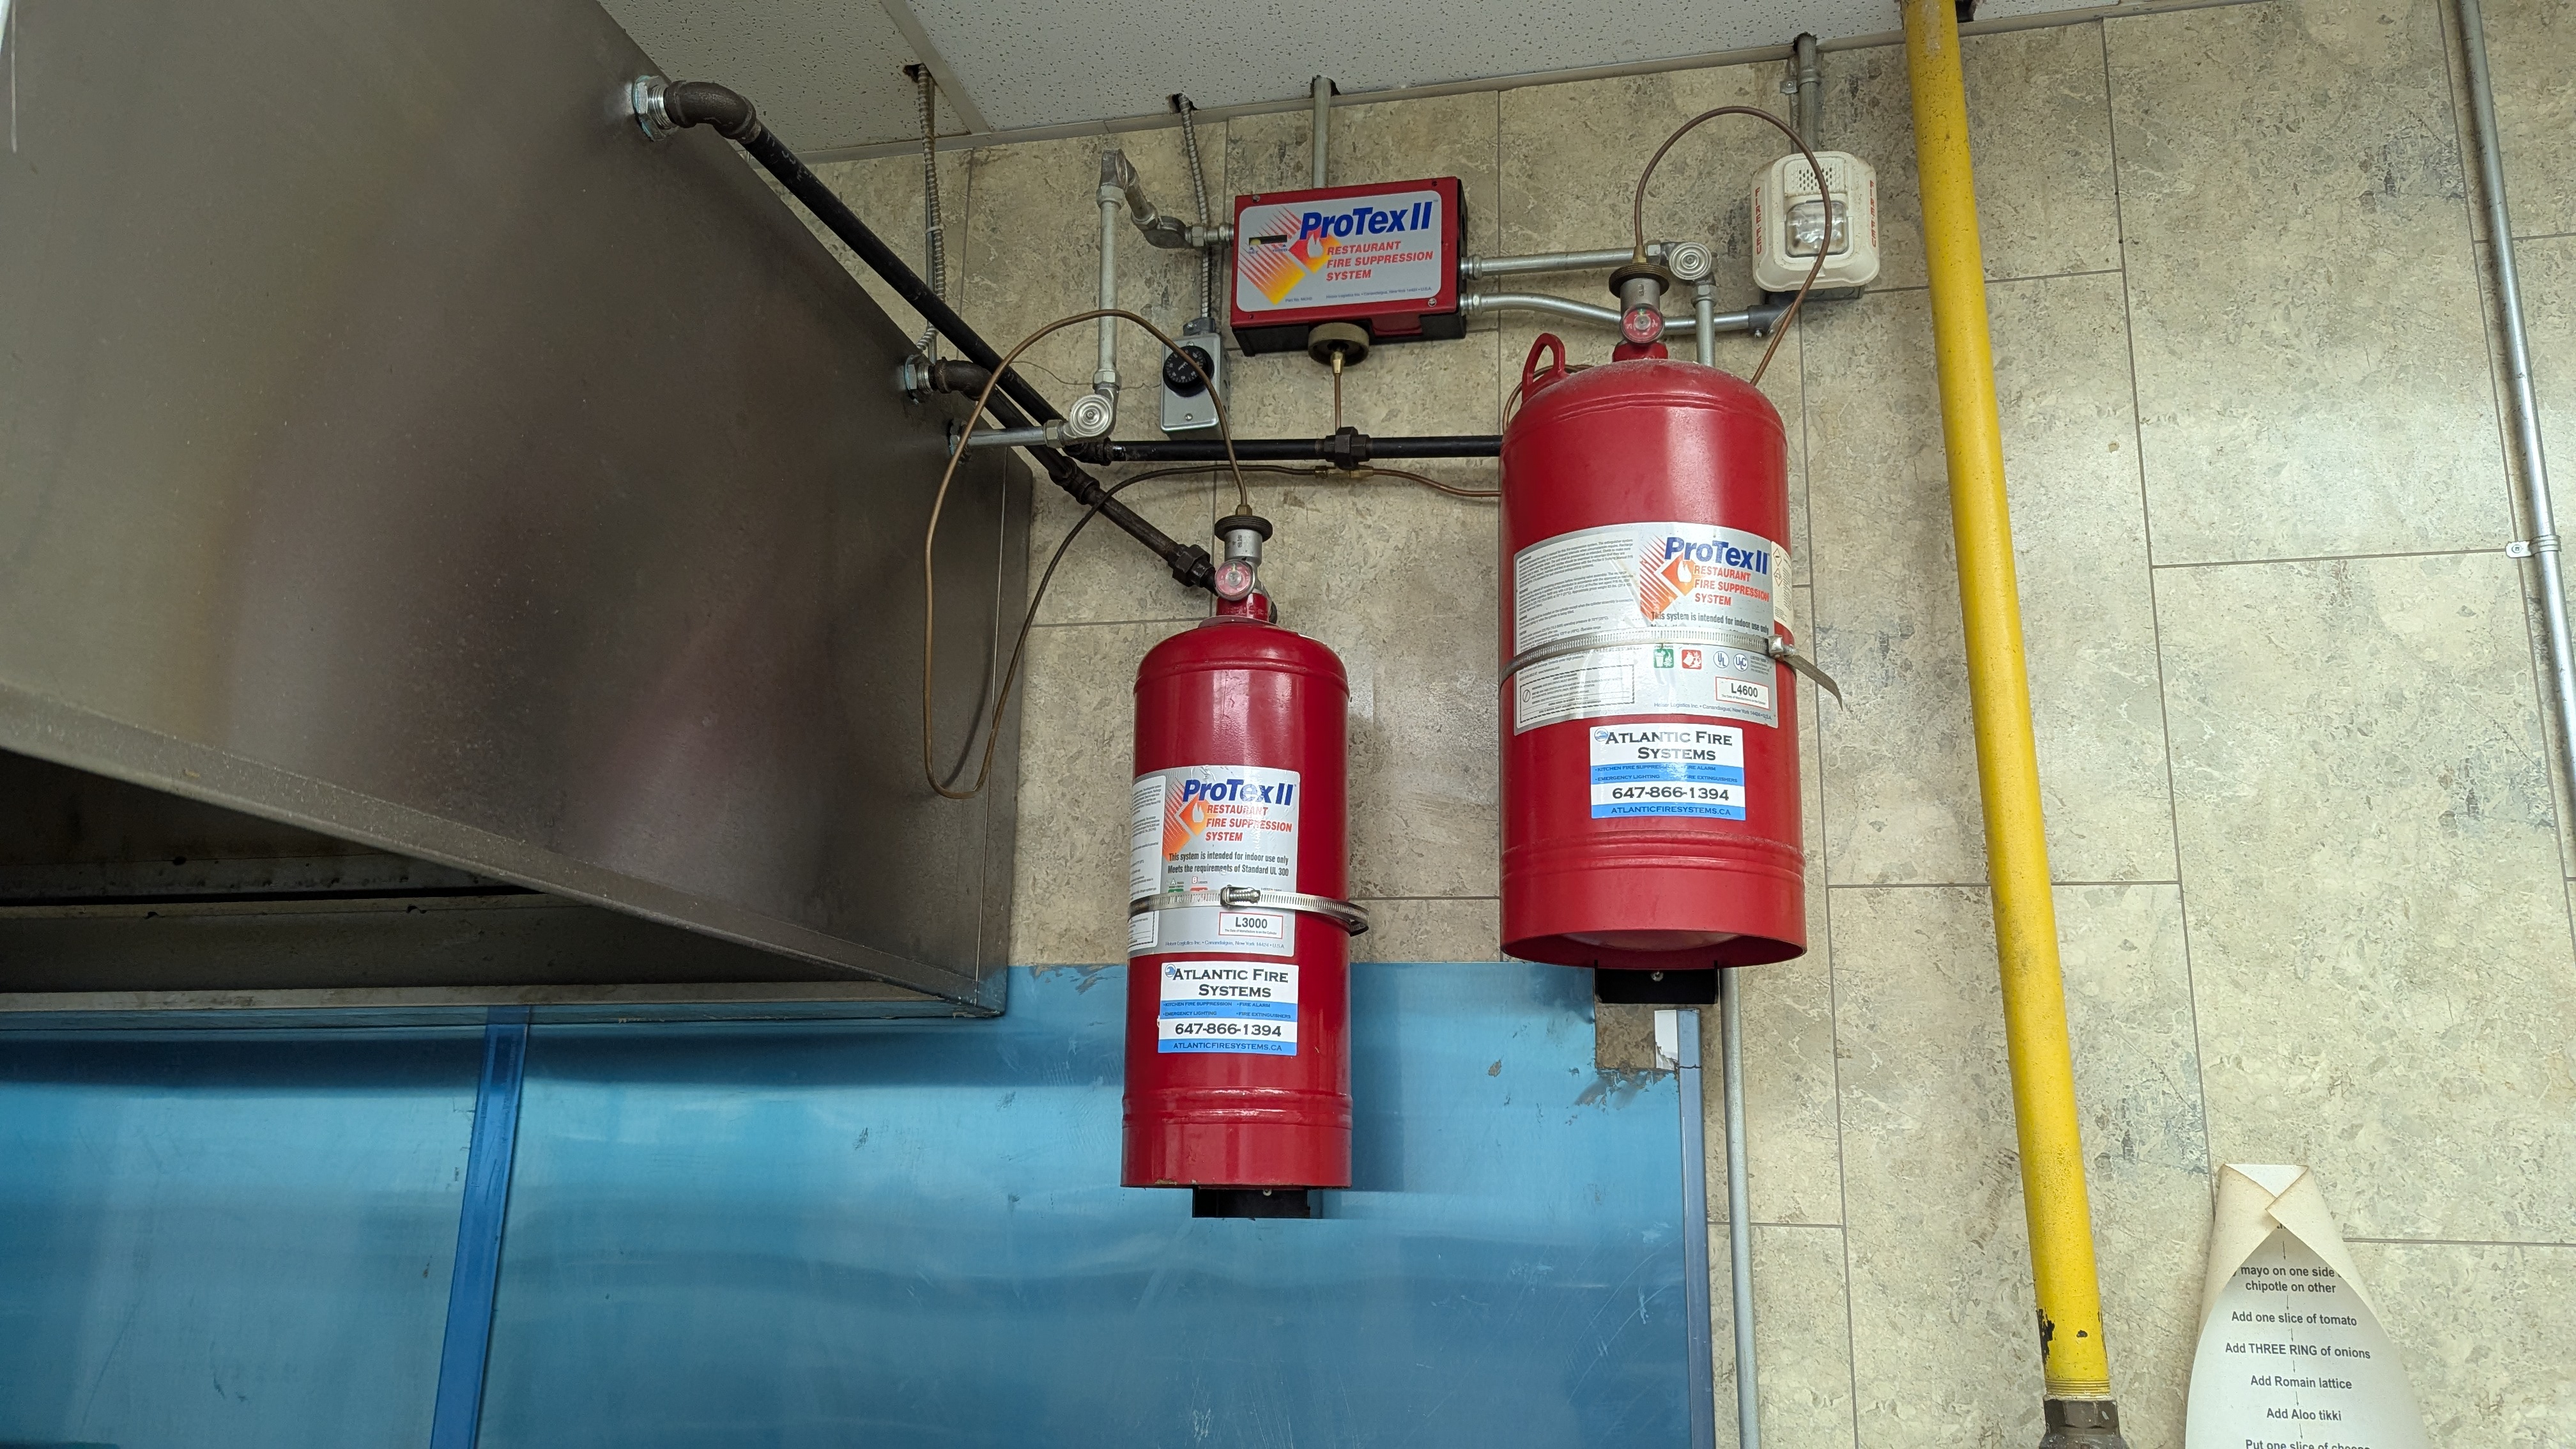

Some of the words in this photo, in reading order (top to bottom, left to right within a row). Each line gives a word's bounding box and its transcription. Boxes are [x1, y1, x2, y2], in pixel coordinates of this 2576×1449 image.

[1327, 240, 1401, 256] RESTAURANT
[1326, 258, 1351, 269] FIRE
[1354, 251, 1433, 266] SUPPRESSION
[1326, 269, 1372, 282] SYSTEM
[1694, 565, 1751, 582] RESTAURANT
[1694, 579, 1715, 590] FIRE
[1717, 581, 1769, 602] SUPPRESSION
[1694, 593, 1731, 606] SYSTEM
[1651, 611, 1665, 621] This
[1666, 612, 1689, 622] system
[1690, 612, 1696, 621] is
[1698, 613, 1724, 624] intended
[1725, 615, 1733, 625] for
[1734, 617, 1751, 629] indoor
[1751, 622, 1759, 631] use
[1760, 624, 1769, 636] only
[1731, 682, 1758, 698] L4600
[1606, 731, 1690, 745] ATLANTIC
[1696, 731, 1733, 746] FIRE
[1637, 747, 1716, 761] SYSTEMS
[1612, 786, 1729, 801] 647-866-1394
[1206, 804, 1268, 816] RESTAURANT
[1611, 806, 1731, 816] ATLANTICFIRESYSTEMS.CA
[1206, 818, 1227, 827] FIRE
[1229, 818, 1292, 832] SUPPRESSION
[1206, 832, 1243, 841] SYSTEM
[1169, 852, 1179, 861] This
[1180, 852, 1199, 862] system
[1200, 851, 1206, 860] is
[1207, 851, 1233, 861] intended
[1234, 851, 1243, 861] for
[1245, 852, 1264, 862] indoor
[1276, 855, 1289, 866] only
[1168, 865, 1183, 874] Meets
[1184, 864, 1193, 873] the
[1194, 863, 1233, 874] requirements
[1234, 864, 1241, 873] of
[1241, 864, 1269, 875] Standard
[1269, 866, 1277, 875] UL
[1278, 868, 1289, 877] 300
[1235, 917, 1268, 929] L3000
[1172, 968, 1248, 981] ATLANTIC
[1253, 969, 1289, 983] FIRE
[1199, 984, 1271, 998] SYSTEMS
[1175, 1022, 1282, 1037] 647-866-1394
[1173, 1042, 1282, 1052] ATLANTICFIRESYSTEMS.CA
[2241, 1266, 2269, 1278] mayo
[2273, 1267, 2286, 1276] on
[2289, 1268, 2309, 1276] one
[2312, 1266, 2335, 1277] side
[2245, 1280, 2288, 1293] chipotle
[2291, 1283, 2304, 1292] on
[2308, 1282, 2336, 1293] other
[2232, 1311, 2253, 1322] Add
[2255, 1314, 2275, 1322] one
[2278, 1312, 2303, 1324] slice
[2306, 1313, 2317, 1324] of
[2319, 1314, 2358, 1326] tomato
[2225, 1342, 2246, 1353] Add
[2248, 1343, 2287, 1355] THREE
[2289, 1344, 2317, 1356] RING
[2320, 1346, 2331, 1356] of
[2334, 1346, 2371, 1359] onions
[2251, 1375, 2272, 1386] Add
[2274, 1376, 2316, 1388] Romain
[2319, 1377, 2352, 1390] lattice
[2267, 1407, 2288, 1419] Add
[2291, 1409, 2316, 1420] Aloo
[2319, 1410, 2342, 1421] tikki
[2246, 1439, 2263, 1449] Put
